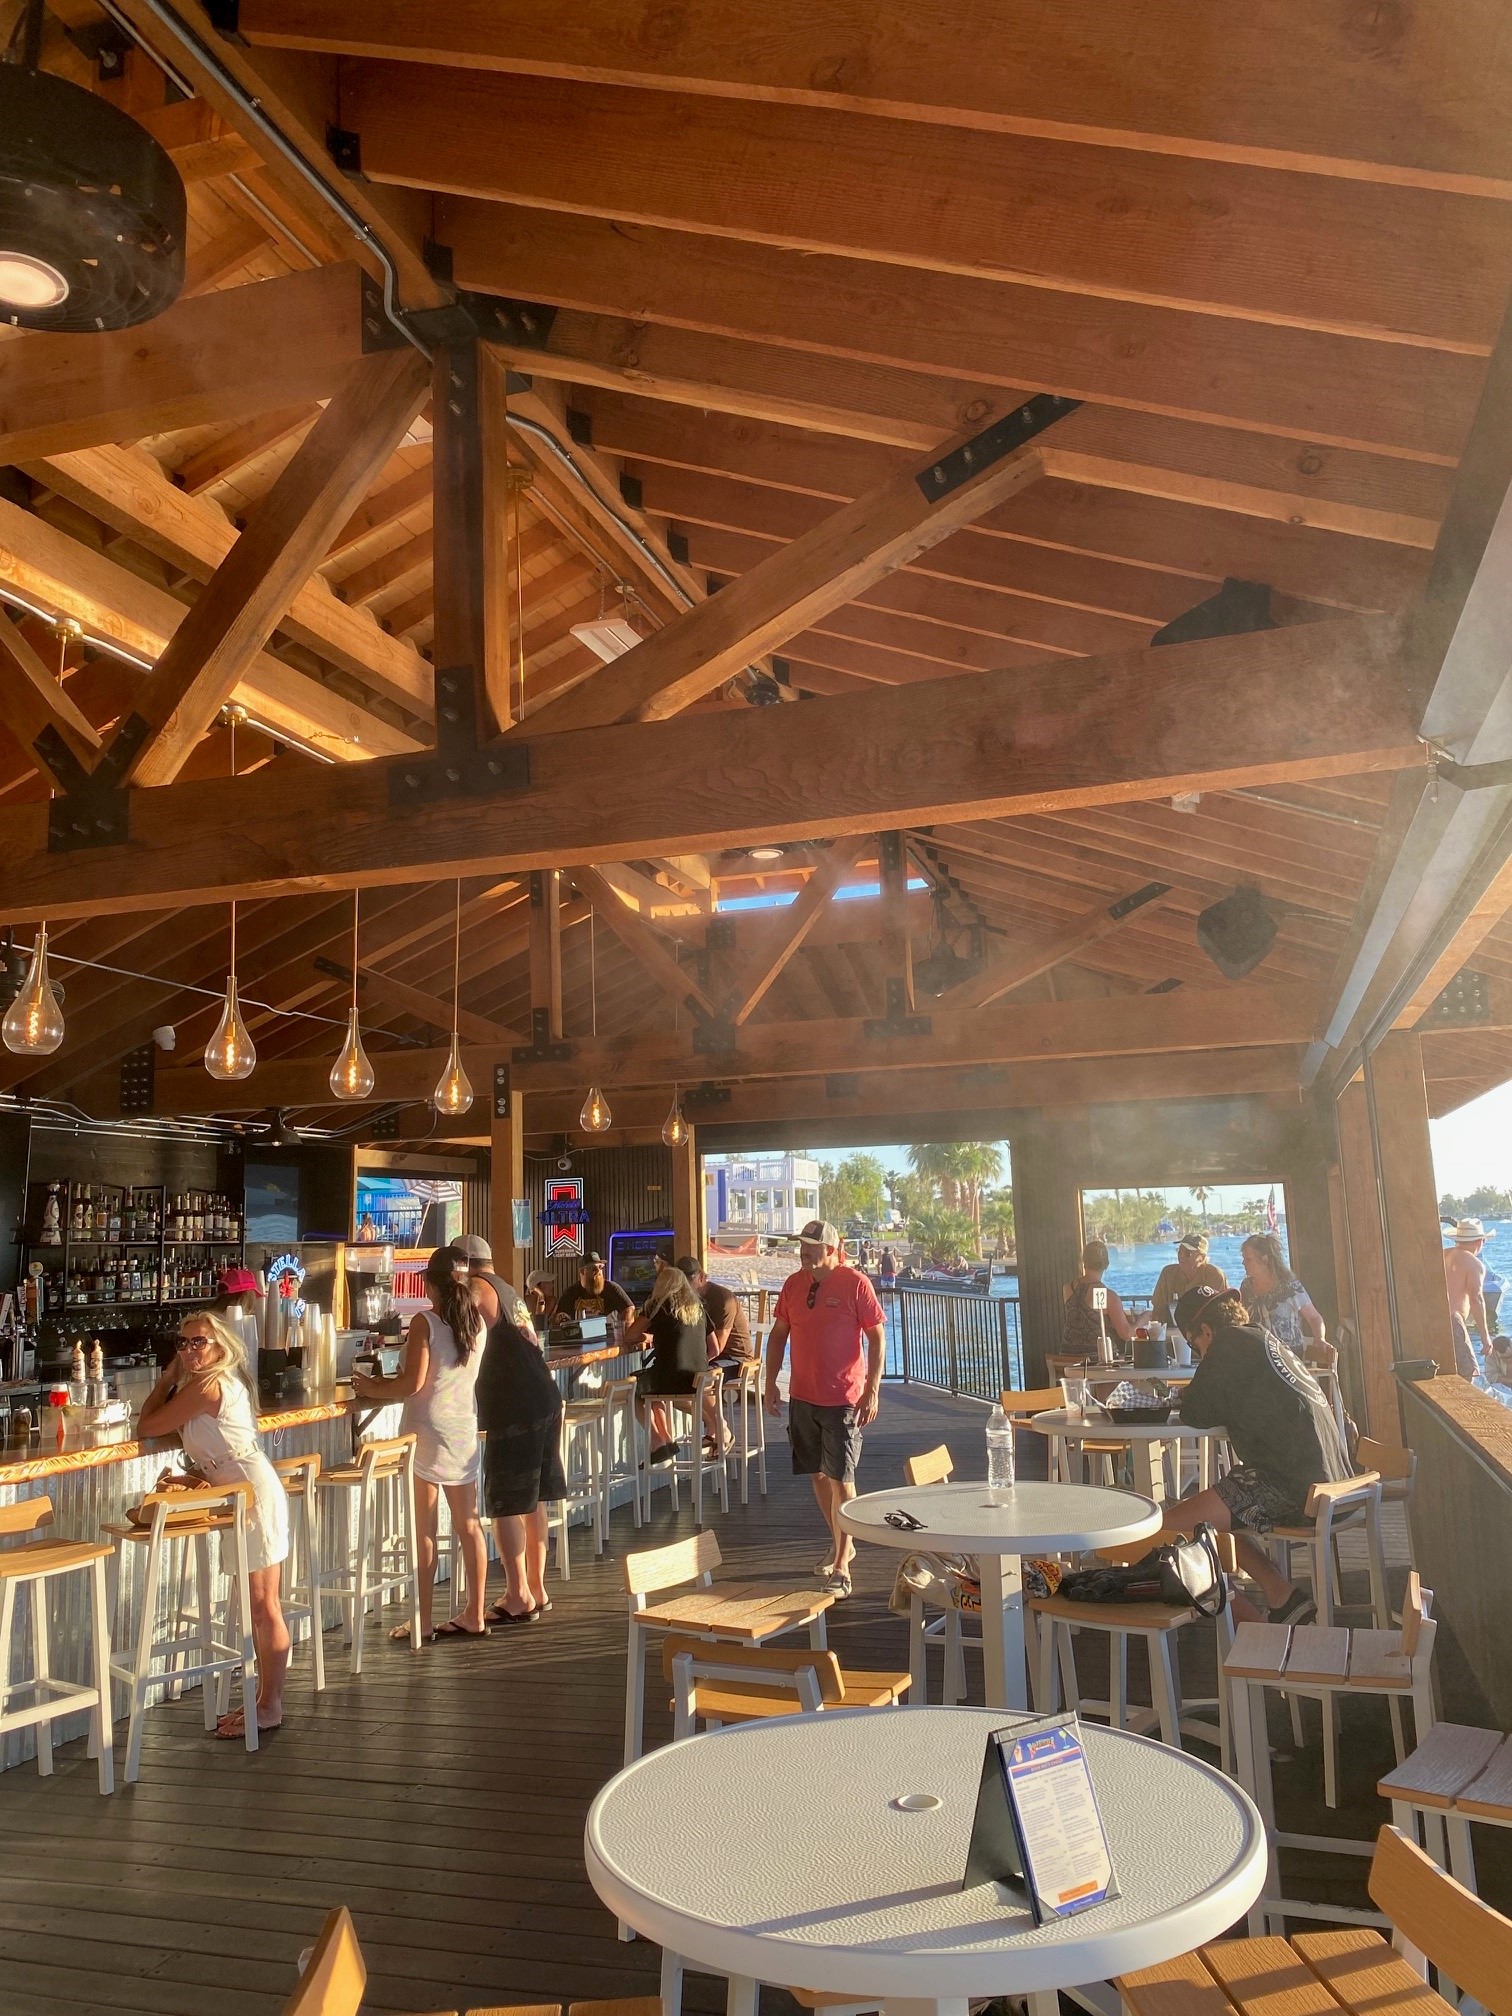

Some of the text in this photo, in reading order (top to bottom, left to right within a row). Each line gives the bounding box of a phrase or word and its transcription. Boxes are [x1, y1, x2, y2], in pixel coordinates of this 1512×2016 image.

[540, 1208, 591, 1224] ULTRA
[267, 1253, 306, 1284] STELLA
[1095, 1291, 1105, 1306] 12
[1268, 1340, 1297, 1384] DIAMOND
